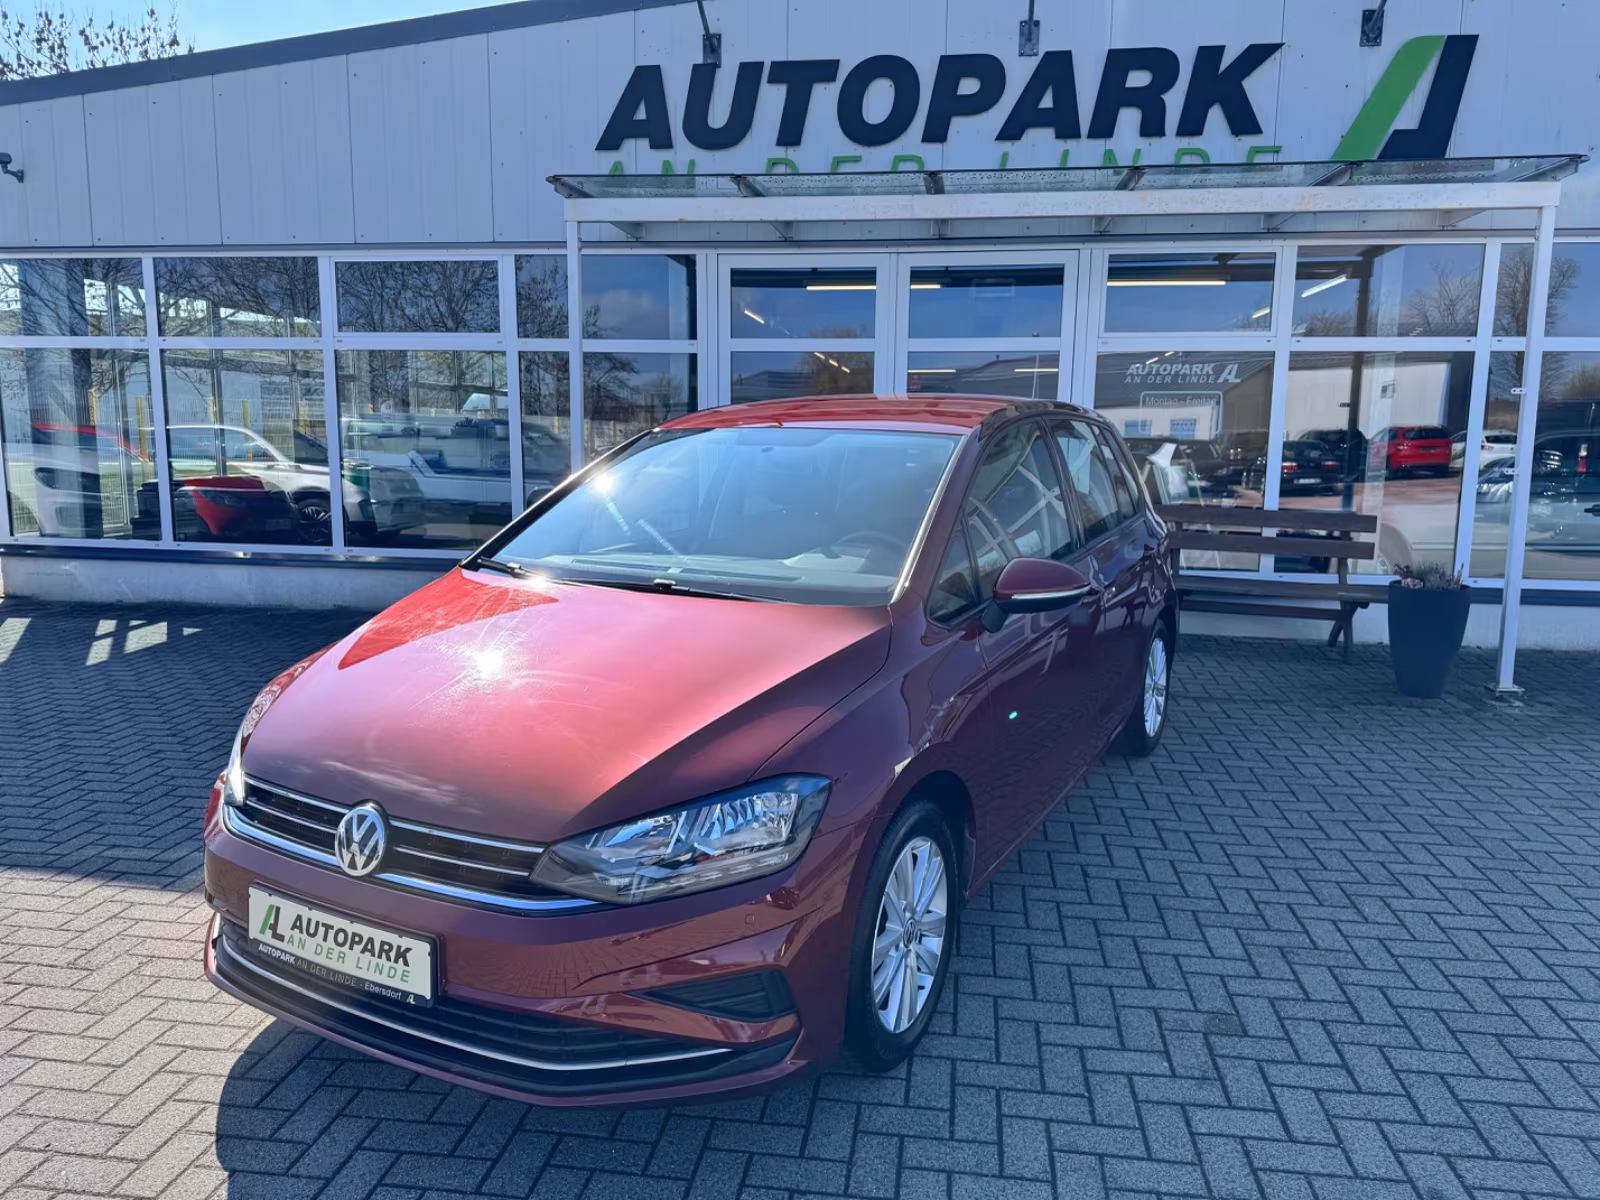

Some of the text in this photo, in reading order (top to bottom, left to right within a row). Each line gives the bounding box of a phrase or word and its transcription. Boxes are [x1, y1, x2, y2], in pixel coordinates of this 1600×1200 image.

[595, 43, 1285, 151] AUTOPARK
[1124, 375, 1217, 384] AN DER LINDE
[1126, 363, 1215, 375] AUTOPARK
[287, 934, 411, 983] AN DER LINDE
[290, 913, 413, 967] AUTOPARK
[258, 943, 296, 966] AUTOPARK
[296, 960, 308, 970] AN
[309, 964, 327, 977] DER
[330, 971, 357, 987] LINDE
[364, 981, 402, 1000] Ebersdorf
